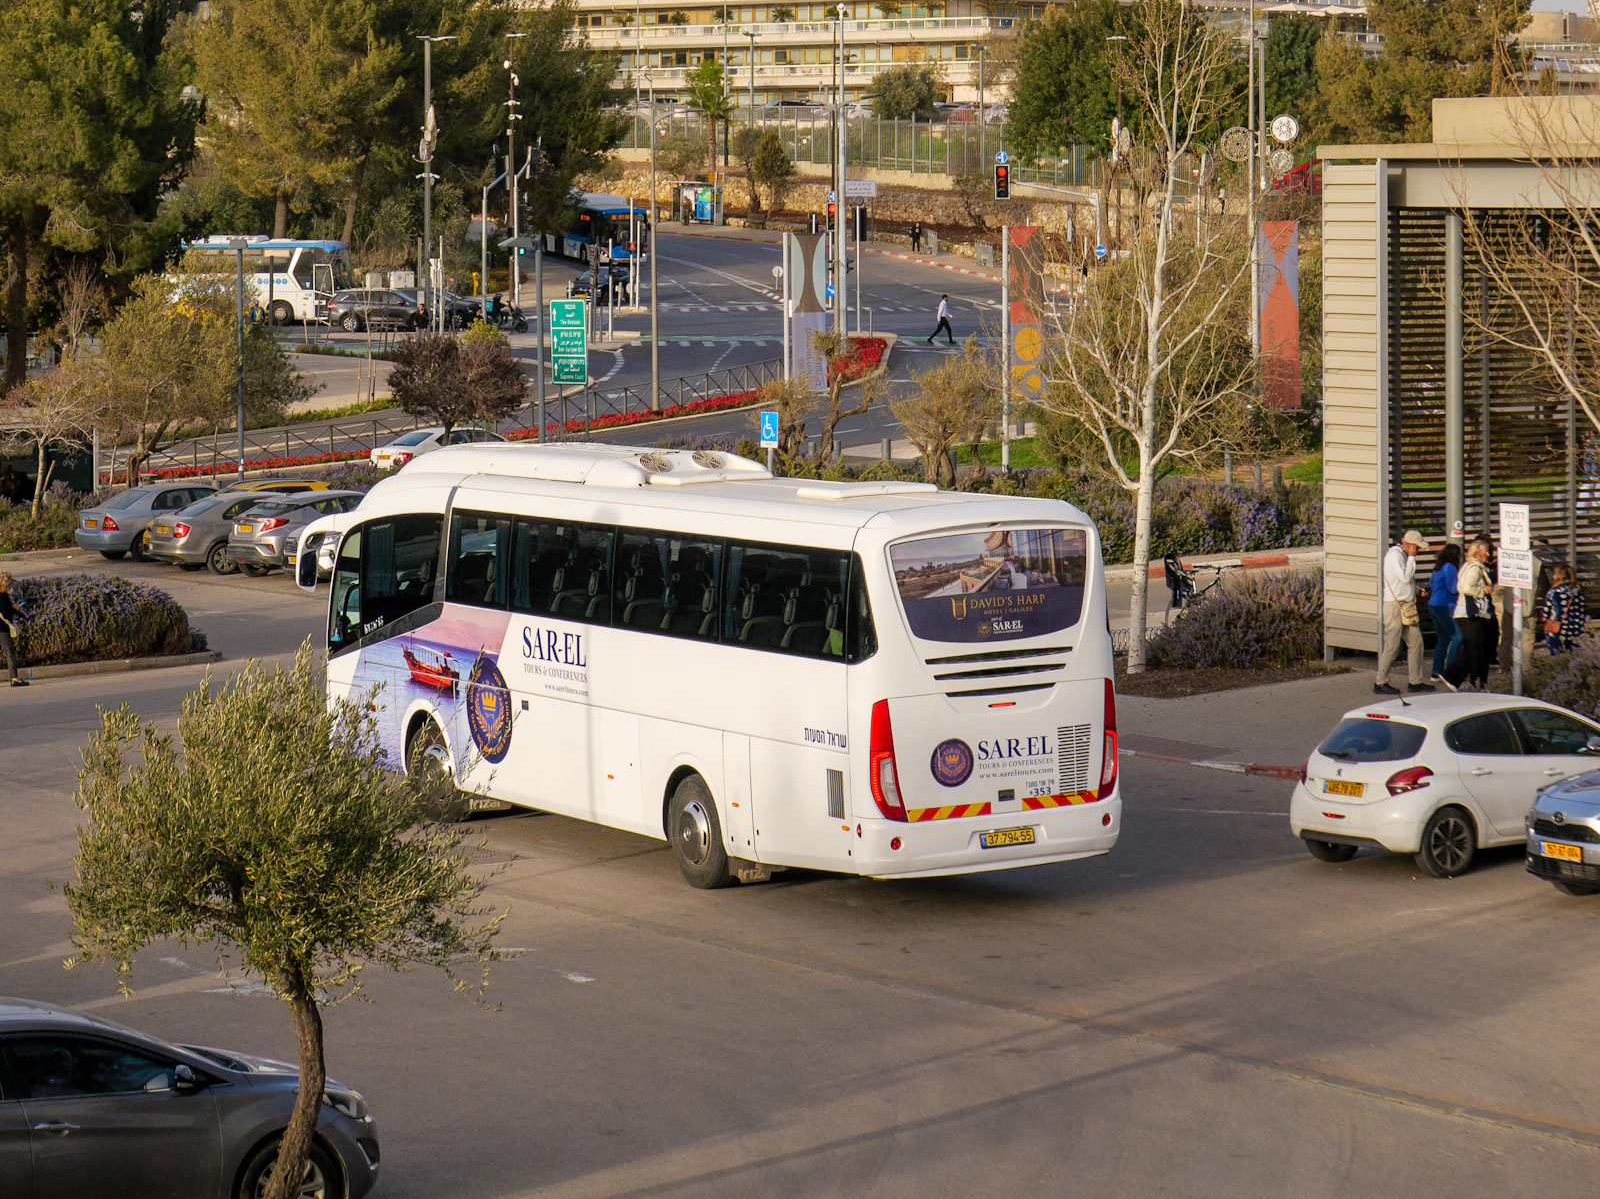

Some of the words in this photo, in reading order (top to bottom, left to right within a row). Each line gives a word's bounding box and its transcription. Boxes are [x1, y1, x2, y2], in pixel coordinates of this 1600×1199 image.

[970, 596, 1012, 609] DAVID'S
[1017, 594, 1045, 605] HARP
[993, 620, 1023, 631] SAR-EL
[523, 626, 586, 667] SAR-EL
[524, 662, 542, 675] TOURS
[543, 666, 547, 676] &
[549, 667, 588, 683] CONFERENCES
[545, 684, 588, 696] www.sareltours.com
[804, 728, 825, 744] הסעות
[977, 736, 1053, 760] SAR-EL
[1008, 758, 1054, 767] CONFERENCES
[980, 768, 1054, 779] www.sareltours.com
